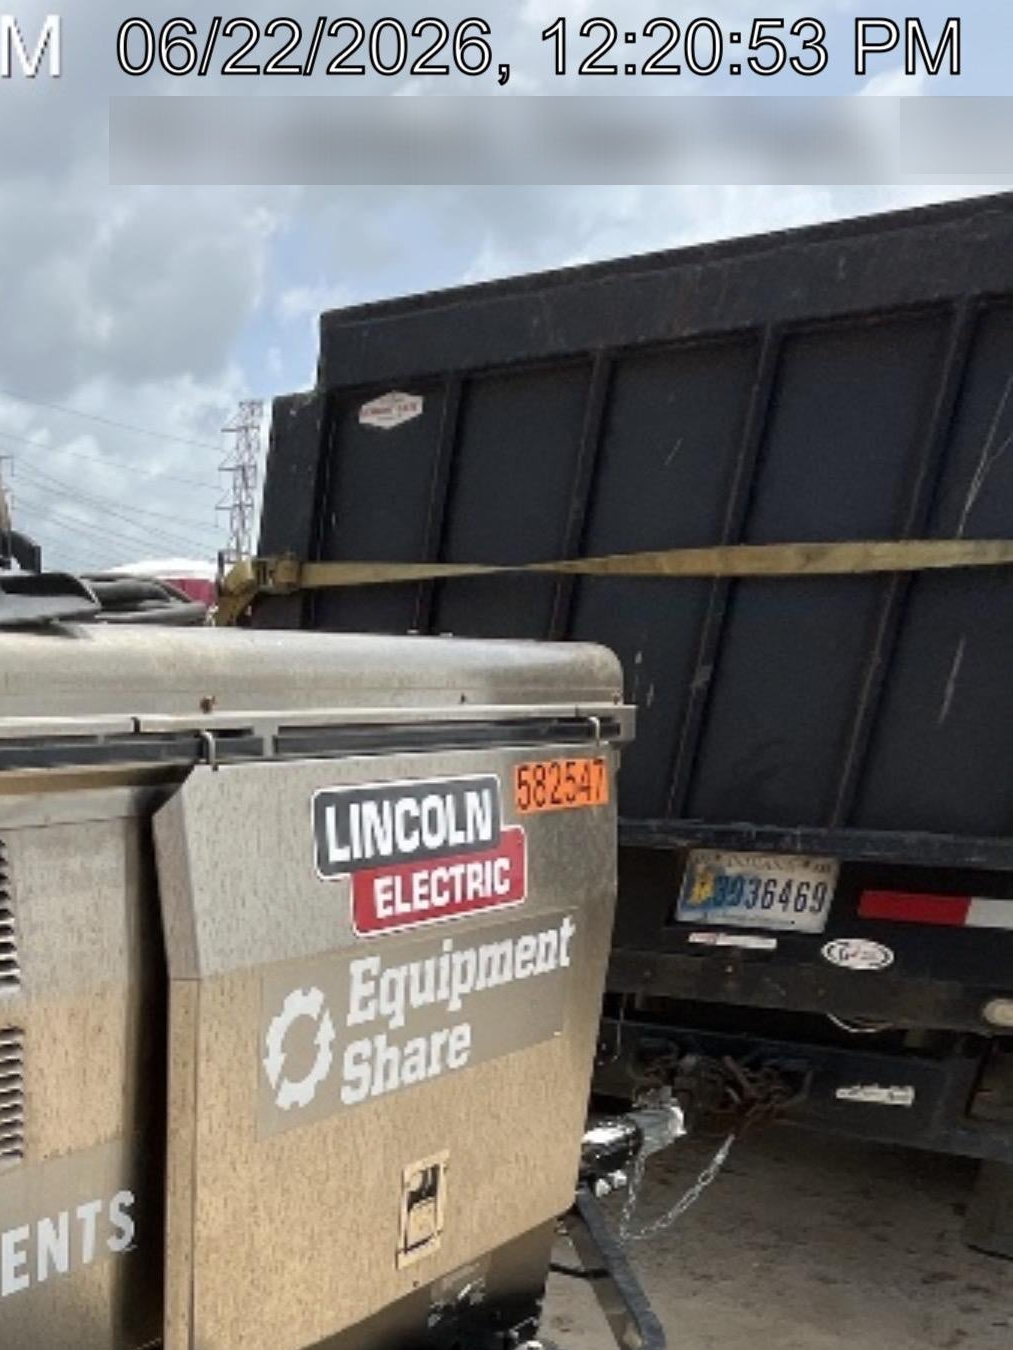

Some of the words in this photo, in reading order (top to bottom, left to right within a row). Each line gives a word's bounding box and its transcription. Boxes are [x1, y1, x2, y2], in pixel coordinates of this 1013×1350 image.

[517, 758, 605, 811] 582547
[325, 788, 493, 863] LINCOLN
[373, 857, 510, 919] ELECTRIC
[347, 916, 576, 1029] Equipment
[341, 1022, 471, 1105] Share
